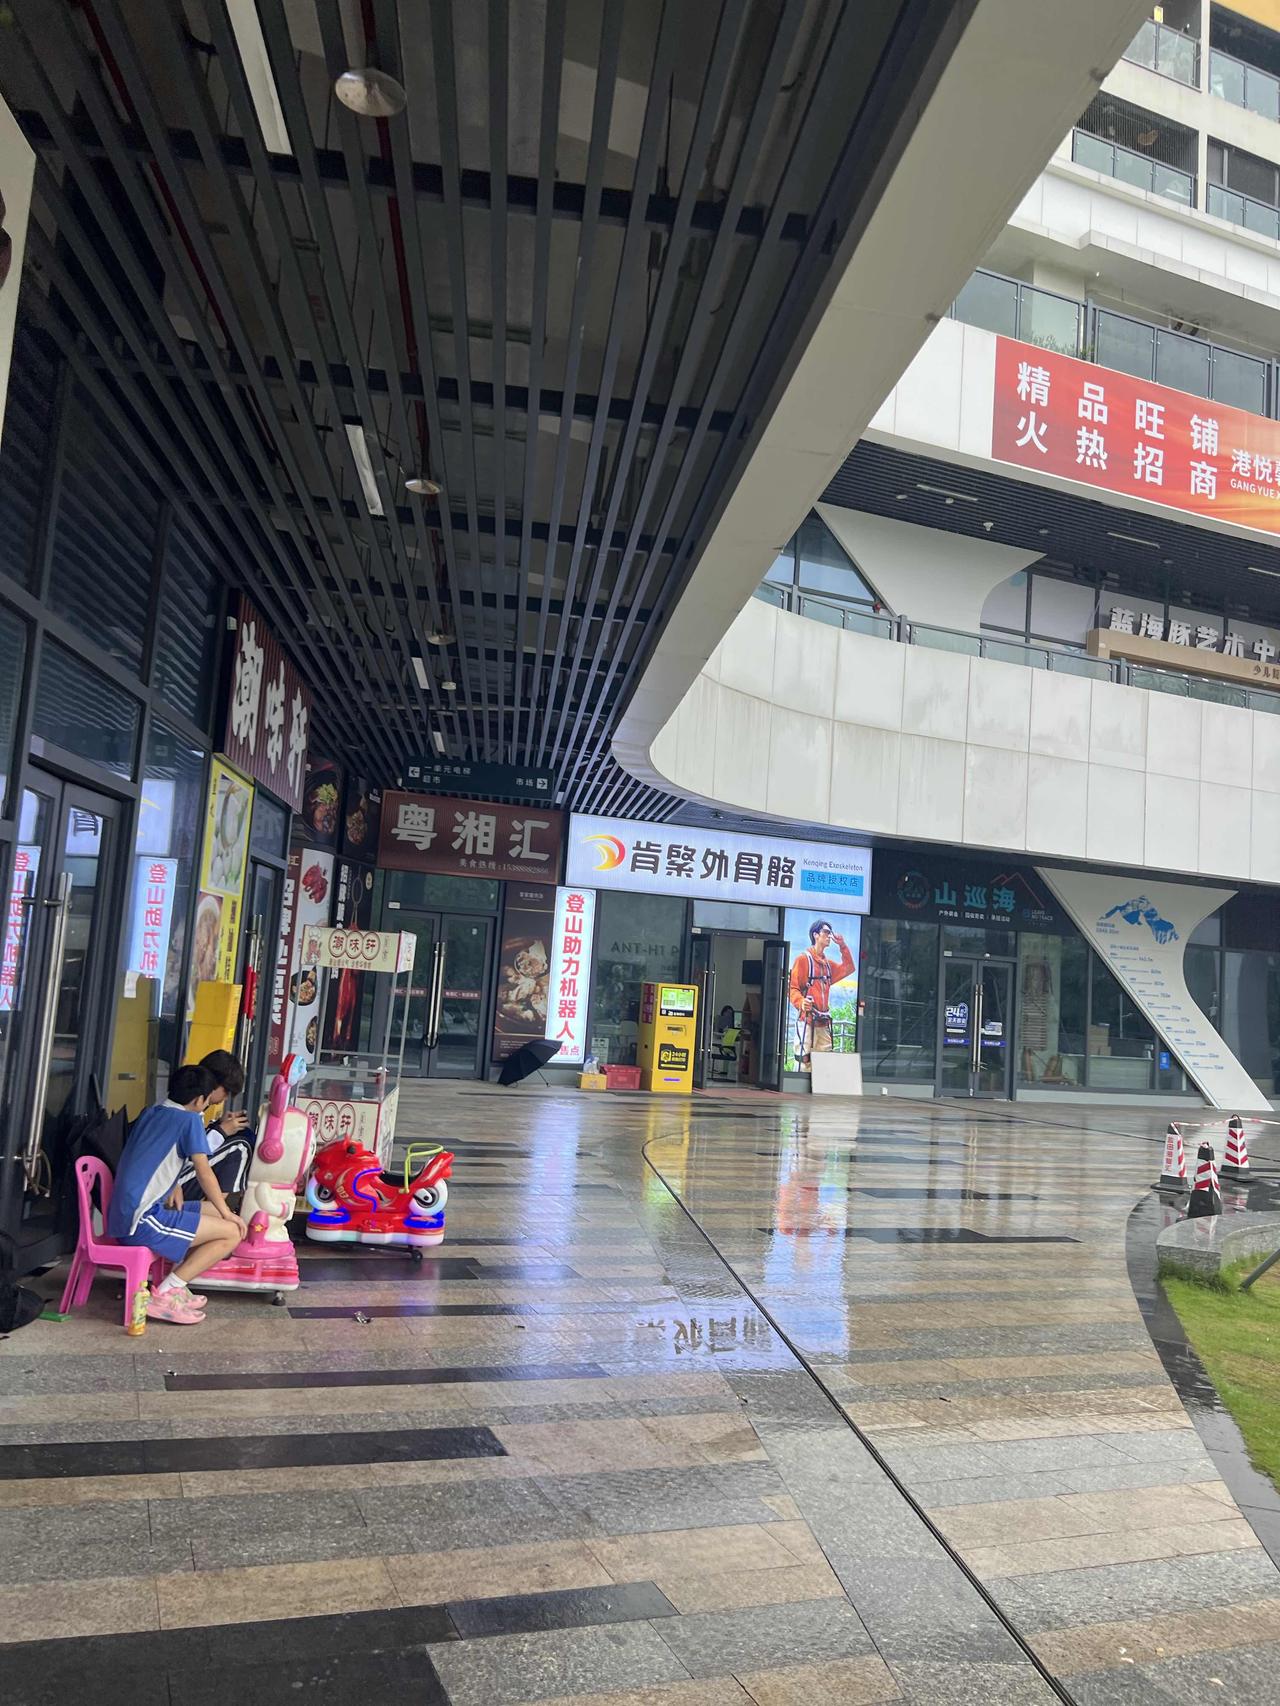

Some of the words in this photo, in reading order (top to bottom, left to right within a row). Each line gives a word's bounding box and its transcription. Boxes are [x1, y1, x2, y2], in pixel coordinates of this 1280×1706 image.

[1016, 361, 1219, 457] 精品旺铺
[1014, 411, 1217, 501] 火热招商
[1230, 478, 1256, 494] GANG
[1258, 485, 1275, 499] YUE
[1109, 606, 1277, 663] 蓝海豚艺术中
[231, 620, 308, 799] 潮味轩
[391, 803, 550, 861] 粤湘汇
[806, 872, 859, 888] 品牌授权店
[935, 881, 1016, 913] 山巡海
[555, 893, 585, 1041] 登山助力机器人
